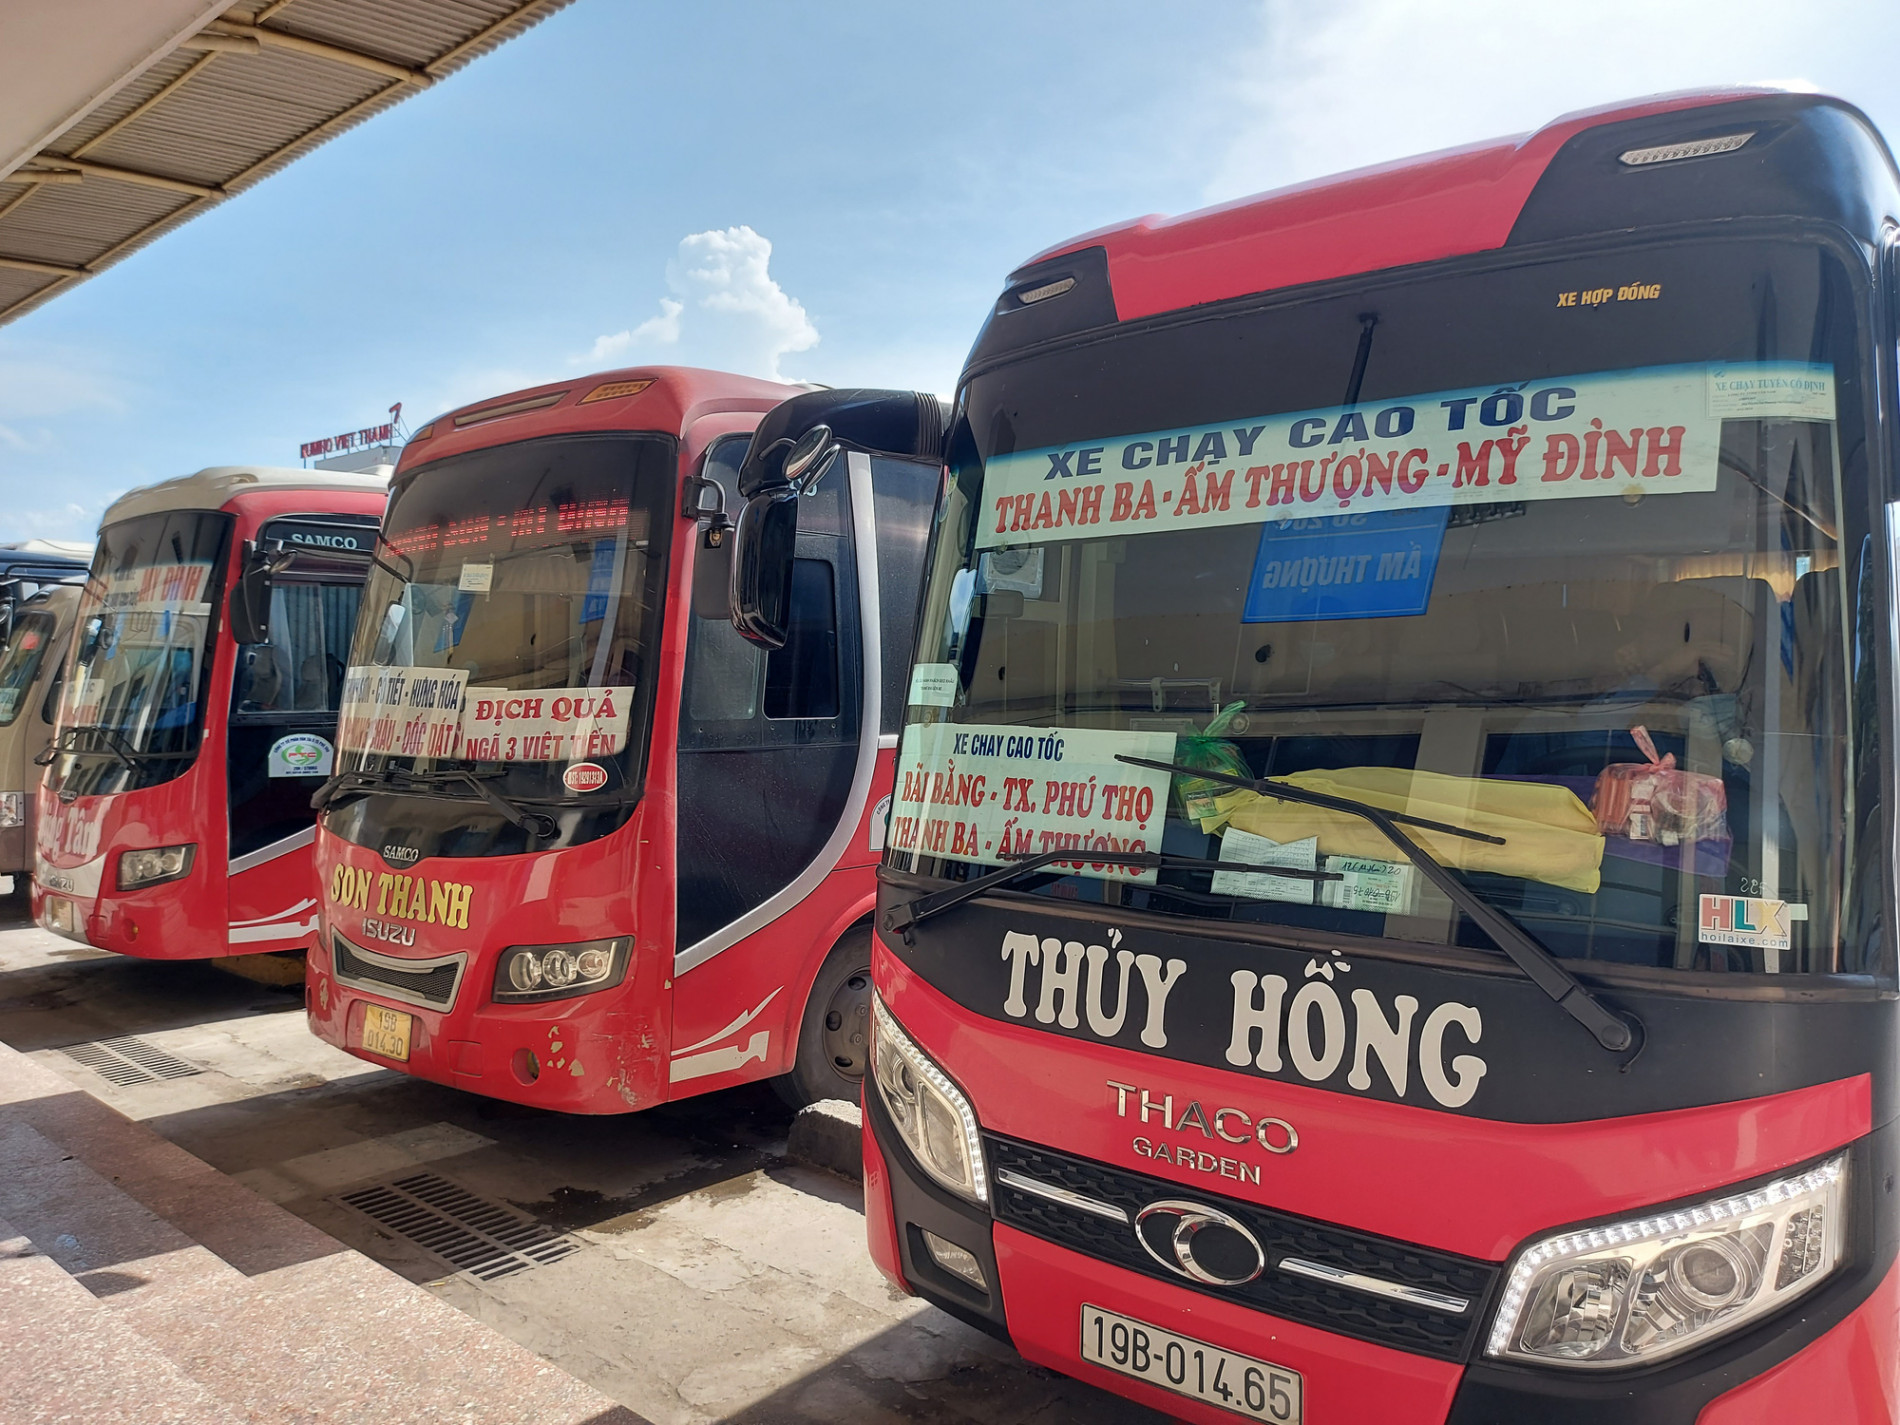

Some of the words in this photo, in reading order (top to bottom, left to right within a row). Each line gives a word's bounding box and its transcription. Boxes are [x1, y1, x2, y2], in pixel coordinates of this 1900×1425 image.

[1556, 292, 1578, 307] XE
[1581, 288, 1613, 307] HỢP
[1715, 382, 1727, 391] XE
[1044, 448, 1104, 480] XE
[1121, 425, 1266, 465] CHẠY
[1288, 406, 1415, 448] CAO
[1440, 380, 1577, 431] TỐC
[995, 485, 1105, 533] THANH
[1540, 417, 1687, 483] ĐÌNH
[291, 533, 358, 549] SAMCO
[475, 698, 544, 727] ĐỊCH
[551, 689, 617, 722] QUẢ
[466, 733, 501, 761] NGÃ
[505, 737, 518, 760] 3
[953, 733, 969, 754] XE
[1006, 735, 1034, 759] CAO
[1038, 731, 1064, 761] TỐC
[901, 762, 930, 802] BÃI
[1002, 777, 1036, 813] TX.
[1042, 775, 1097, 818] PHÚ
[1101, 784, 1154, 831] THỌ
[383, 845, 419, 862] SAMCO
[893, 816, 949, 852] THANH
[950, 821, 980, 857] BA
[377, 872, 473, 930] THANH
[1701, 897, 1788, 937] HLX
[362, 917, 416, 947] ISUZU
[1701, 932, 1788, 948] hoilaixe.com
[1001, 927, 1187, 1049] THỦY
[379, 1010, 397, 1032] 19B
[1106, 1080, 1299, 1155] THACO
[1132, 1136, 1261, 1186] GARDEN
[1093, 1315, 1292, 1421] 19B-014.65
